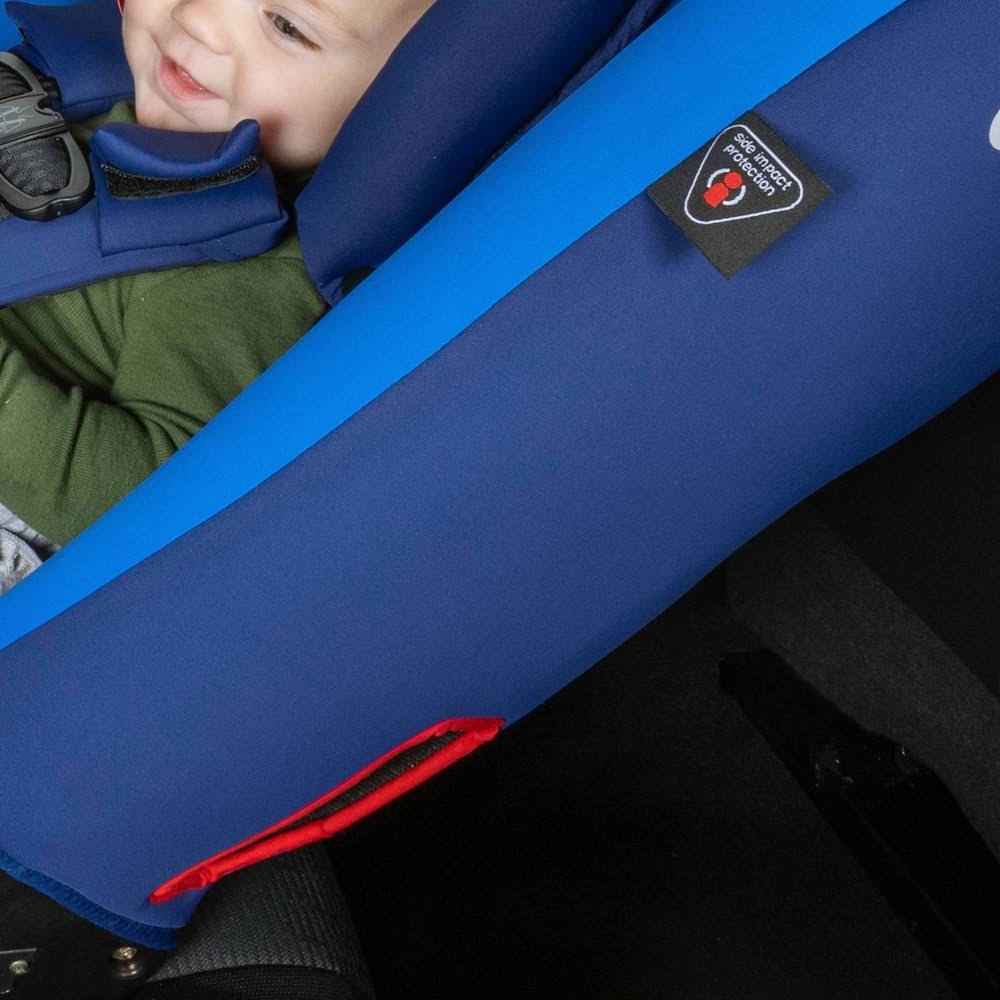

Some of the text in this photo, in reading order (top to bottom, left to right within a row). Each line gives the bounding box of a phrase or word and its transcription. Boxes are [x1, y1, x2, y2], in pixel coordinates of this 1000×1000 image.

[723, 144, 775, 196] protection
[734, 133, 793, 191] side impact
